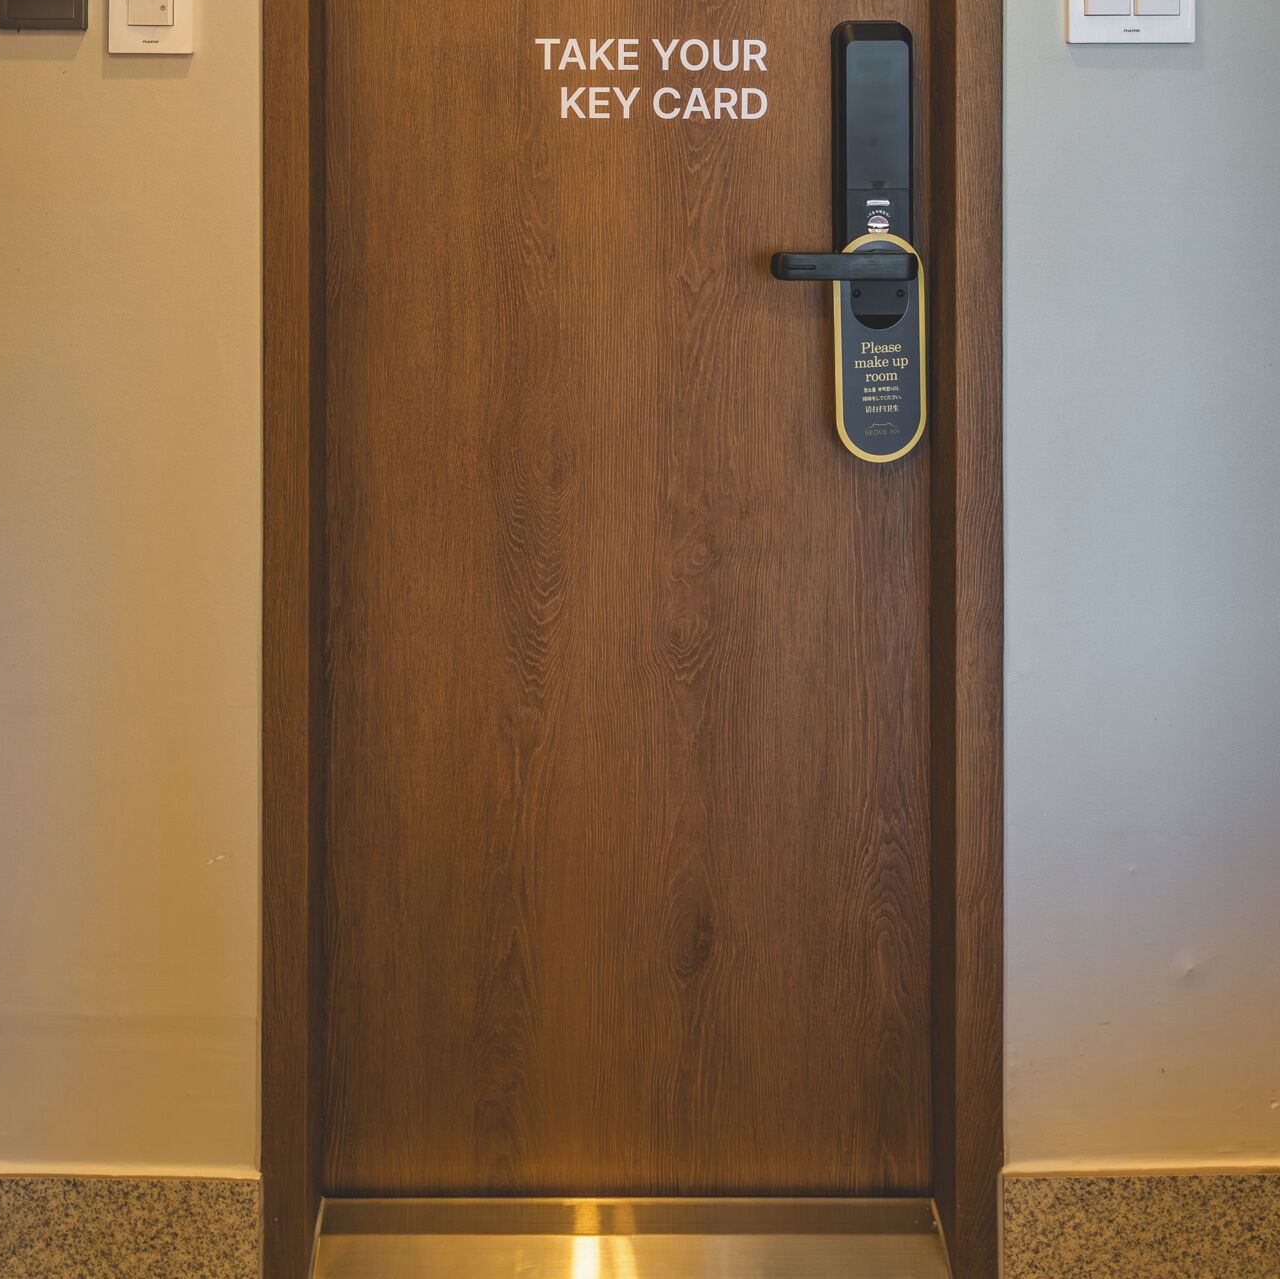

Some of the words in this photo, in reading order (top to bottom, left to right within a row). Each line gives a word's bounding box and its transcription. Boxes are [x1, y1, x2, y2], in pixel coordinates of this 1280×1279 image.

[534, 38, 640, 70] TAKE
[651, 38, 768, 71] YOUR
[560, 86, 641, 119] KEY
[652, 86, 768, 120] CARD
[861, 341, 902, 354] Please
[854, 356, 889, 369] make
[892, 357, 909, 369] up
[865, 372, 899, 382] room
[864, 428, 888, 436] SEOUL
